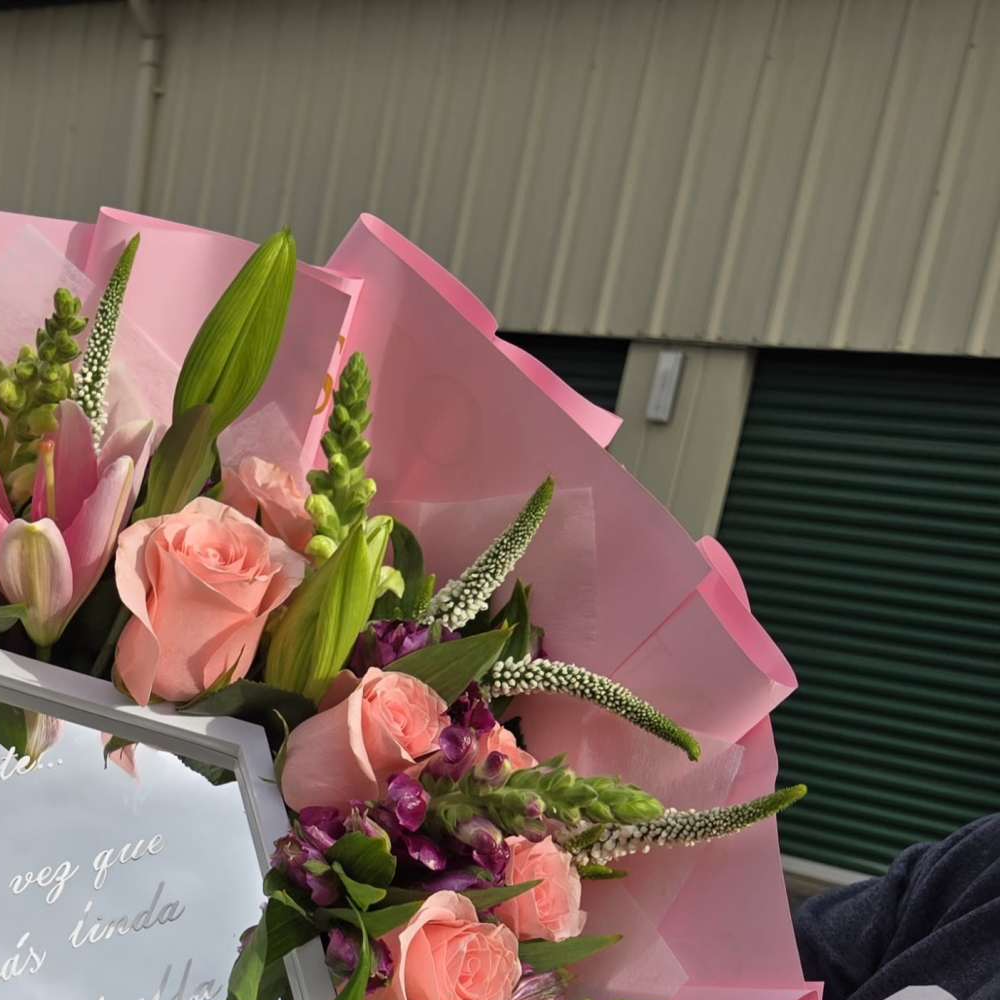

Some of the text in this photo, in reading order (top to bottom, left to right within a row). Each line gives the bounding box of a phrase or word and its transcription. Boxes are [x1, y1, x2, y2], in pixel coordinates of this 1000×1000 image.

[9, 859, 79, 904] vez
[93, 833, 165, 889] que
[68, 881, 186, 948] linda
